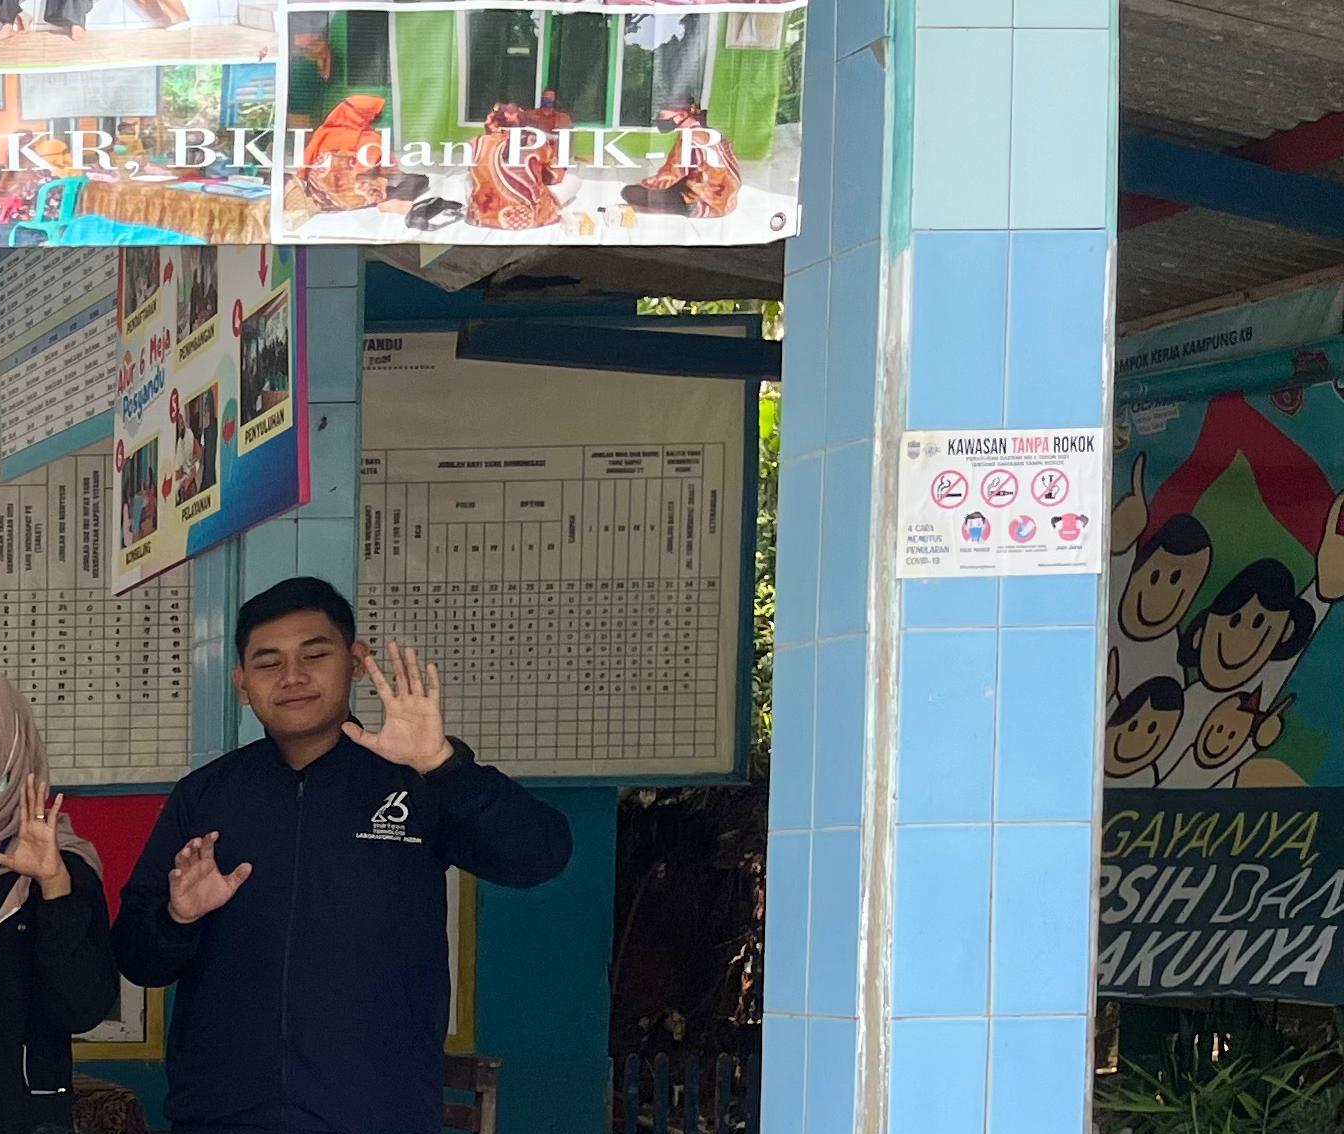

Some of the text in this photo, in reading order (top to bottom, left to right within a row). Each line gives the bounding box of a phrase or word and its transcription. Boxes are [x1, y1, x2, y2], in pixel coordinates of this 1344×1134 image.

[167, 127, 333, 169] BKL
[357, 128, 477, 168] dan
[501, 127, 724, 167] PIK-R
[140, 348, 144, 375] 6
[150, 329, 170, 364] Meja
[179, 325, 214, 361] PENIMBANGAN
[1151, 346, 1180, 365] KERJA
[1182, 331, 1238, 357] KAMPUNG
[1239, 327, 1252, 343] KB
[123, 366, 165, 422] Posyandu
[244, 408, 285, 445] PENYULUHAN
[948, 436, 1094, 455] KAWASAN TANPA ROKOK
[181, 494, 211, 522] PELAYANAN
